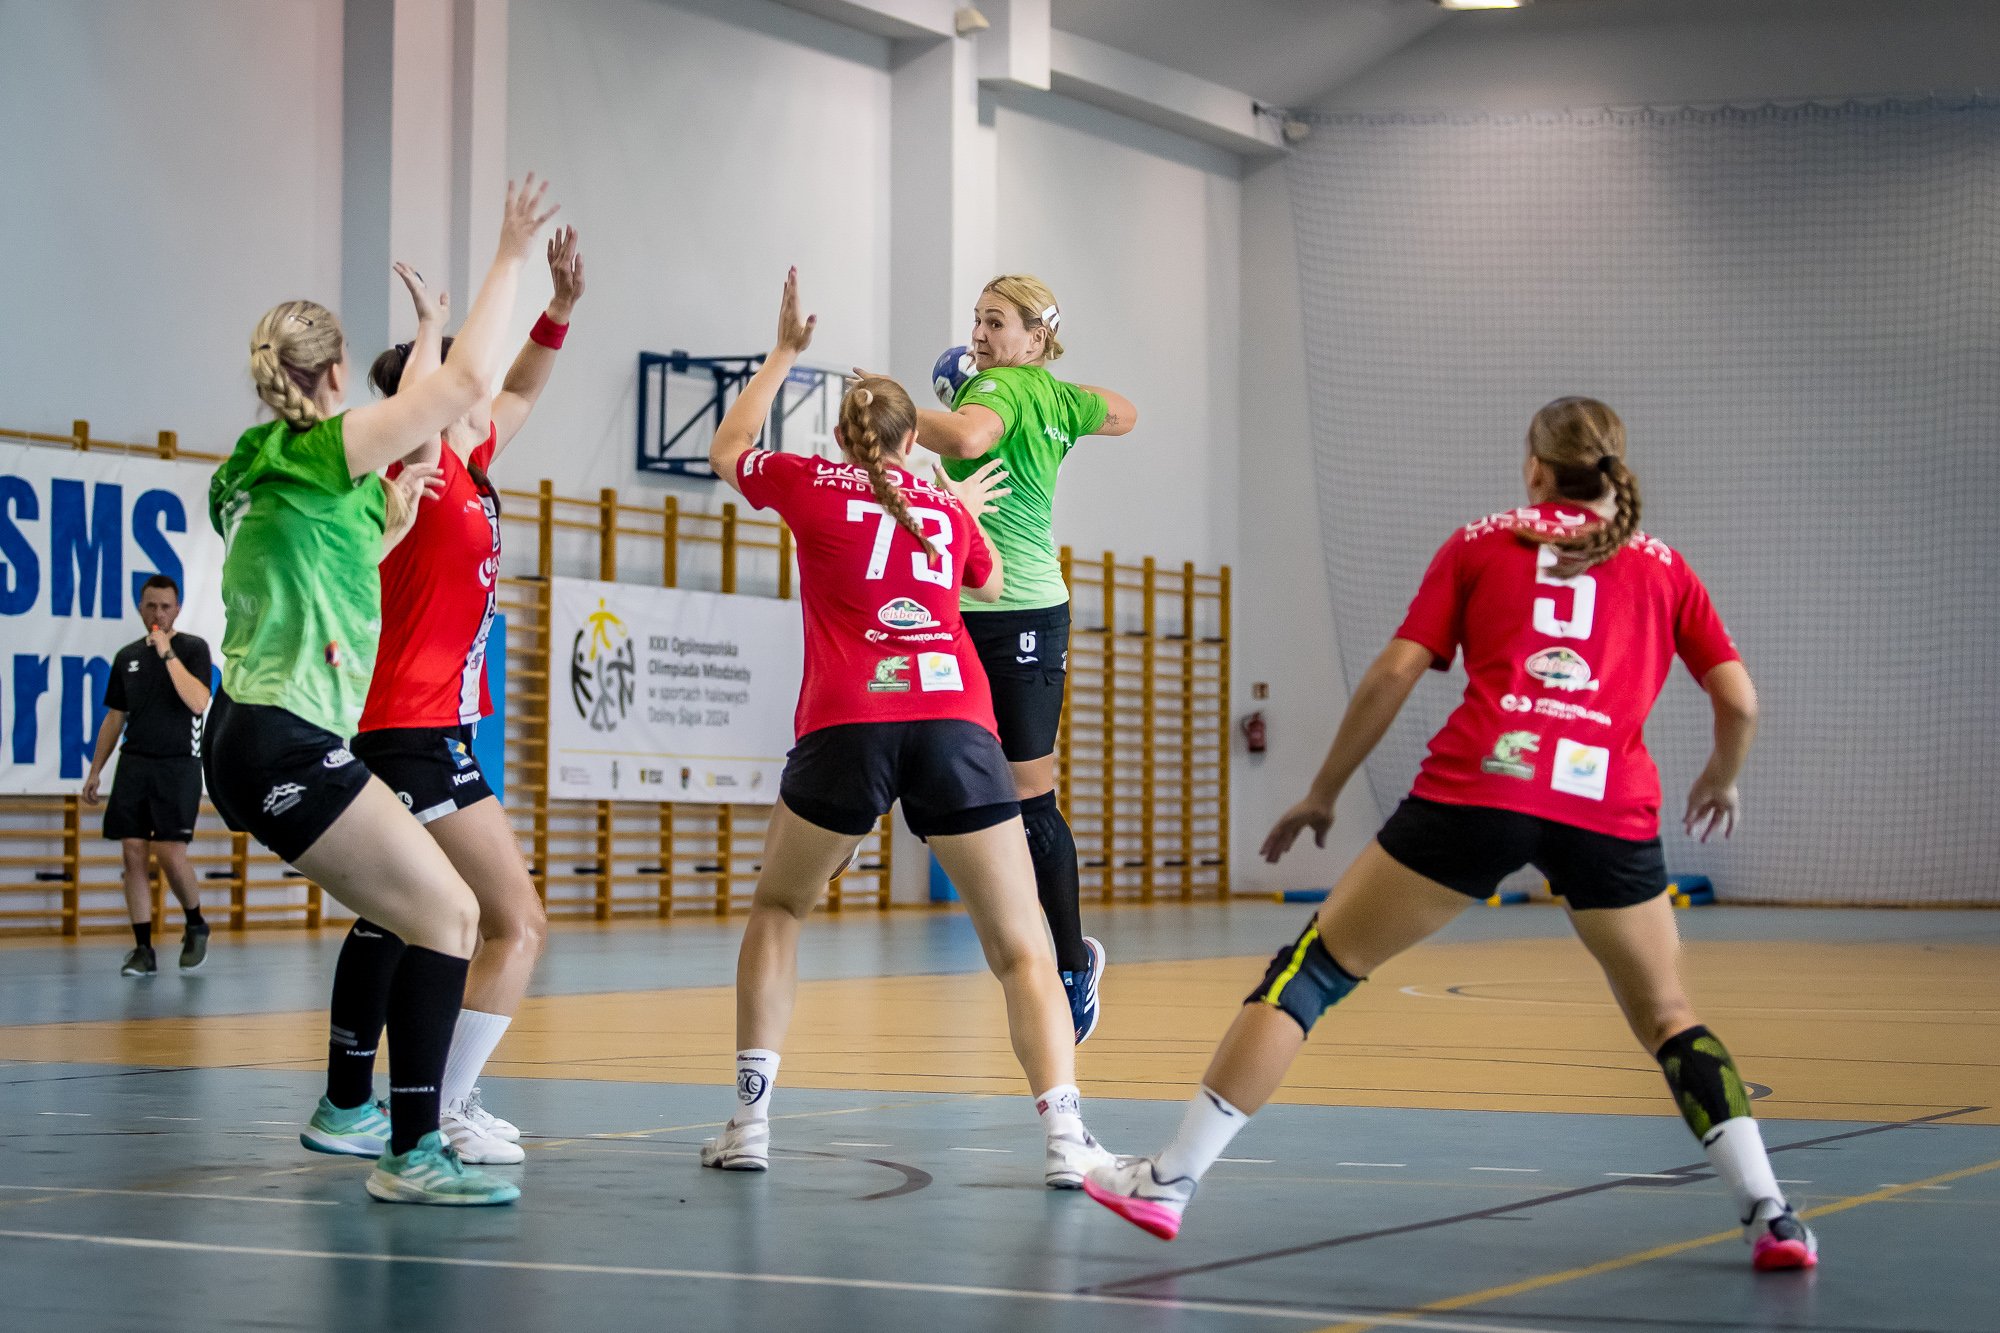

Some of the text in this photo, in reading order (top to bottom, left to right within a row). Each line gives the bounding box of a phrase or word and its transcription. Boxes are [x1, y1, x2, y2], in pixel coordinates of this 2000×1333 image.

[0, 474, 188, 620] SMS
[846, 499, 954, 590] 73
[1532, 543, 1597, 640] 5
[649, 636, 668, 651] XXX
[1020, 630, 1036, 652] 6
